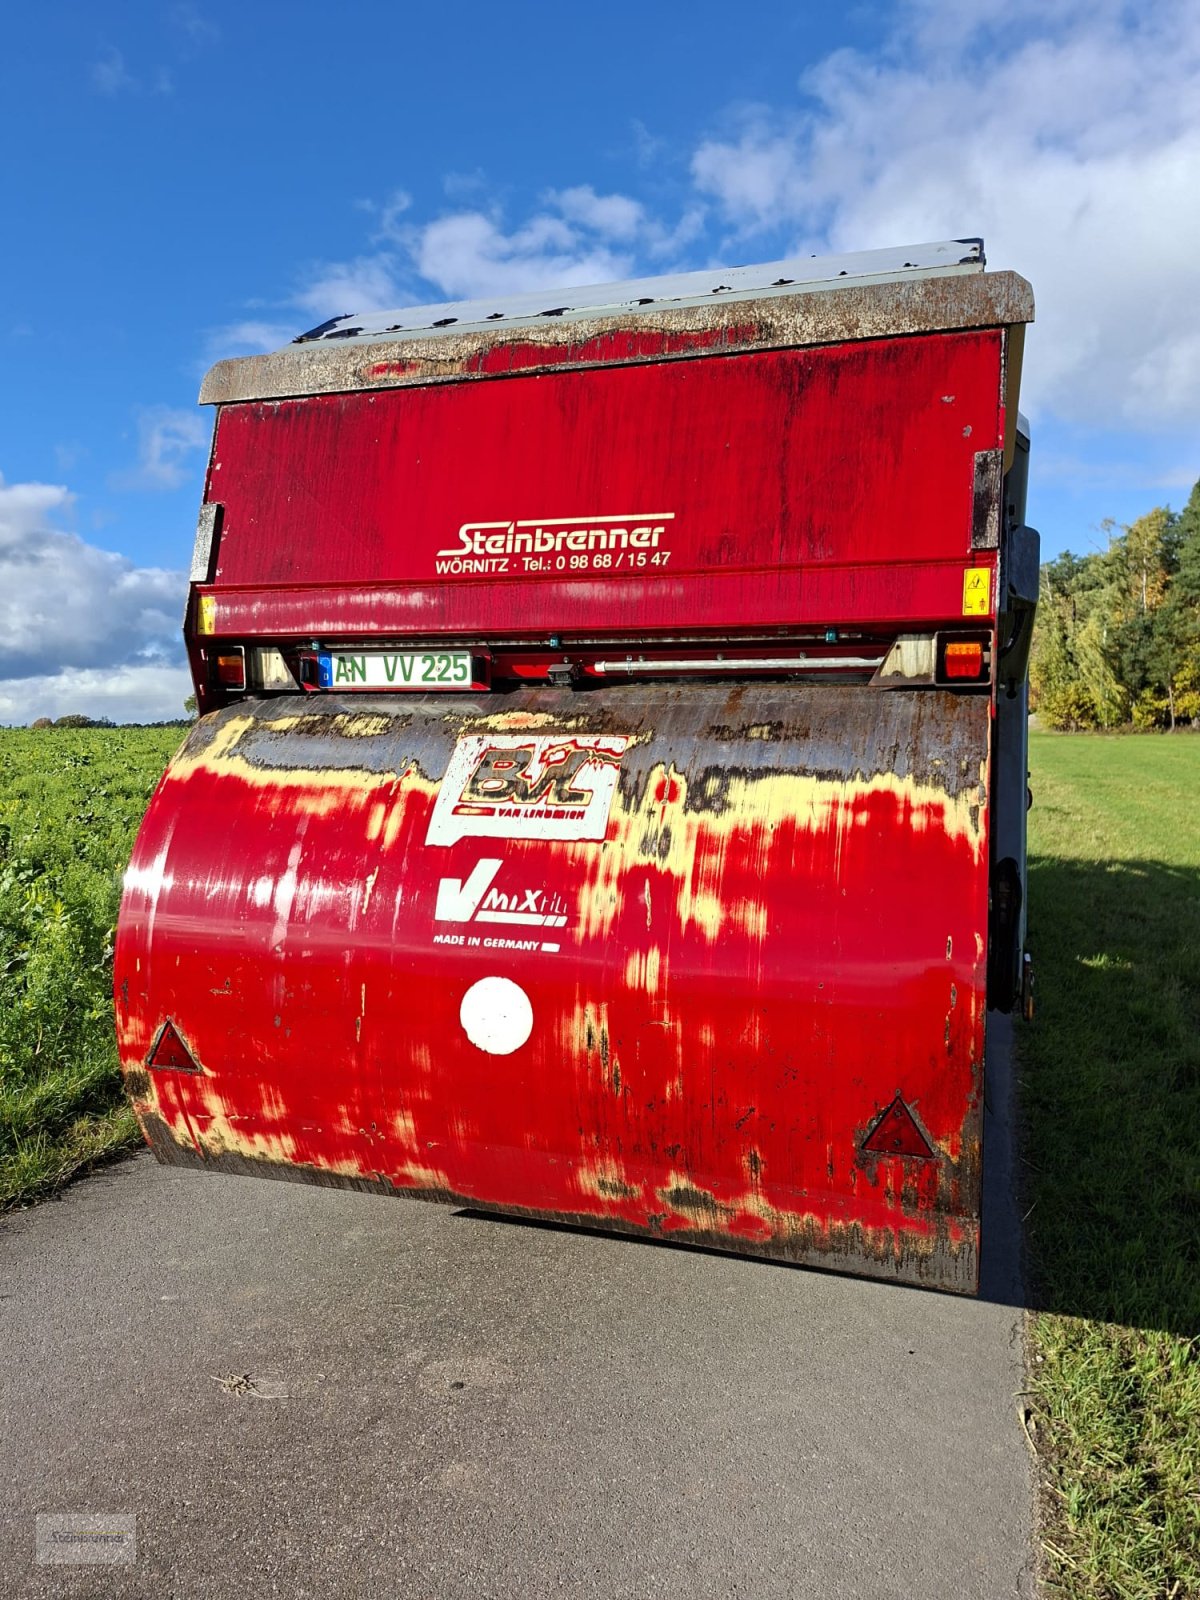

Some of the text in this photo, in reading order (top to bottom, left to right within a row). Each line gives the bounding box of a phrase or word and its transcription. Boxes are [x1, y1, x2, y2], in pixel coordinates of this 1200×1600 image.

[437, 517, 668, 556] Steinbrenner
[436, 557, 509, 575] WÖRNITZ
[556, 555, 566, 570] 0
[569, 555, 588, 569] 98
[593, 554, 612, 568] 68
[628, 552, 647, 566] 15
[651, 551, 671, 566] 47
[335, 655, 367, 682] AN
[421, 655, 468, 682] 225
[433, 934, 540, 951] MADE IN GERMANY
